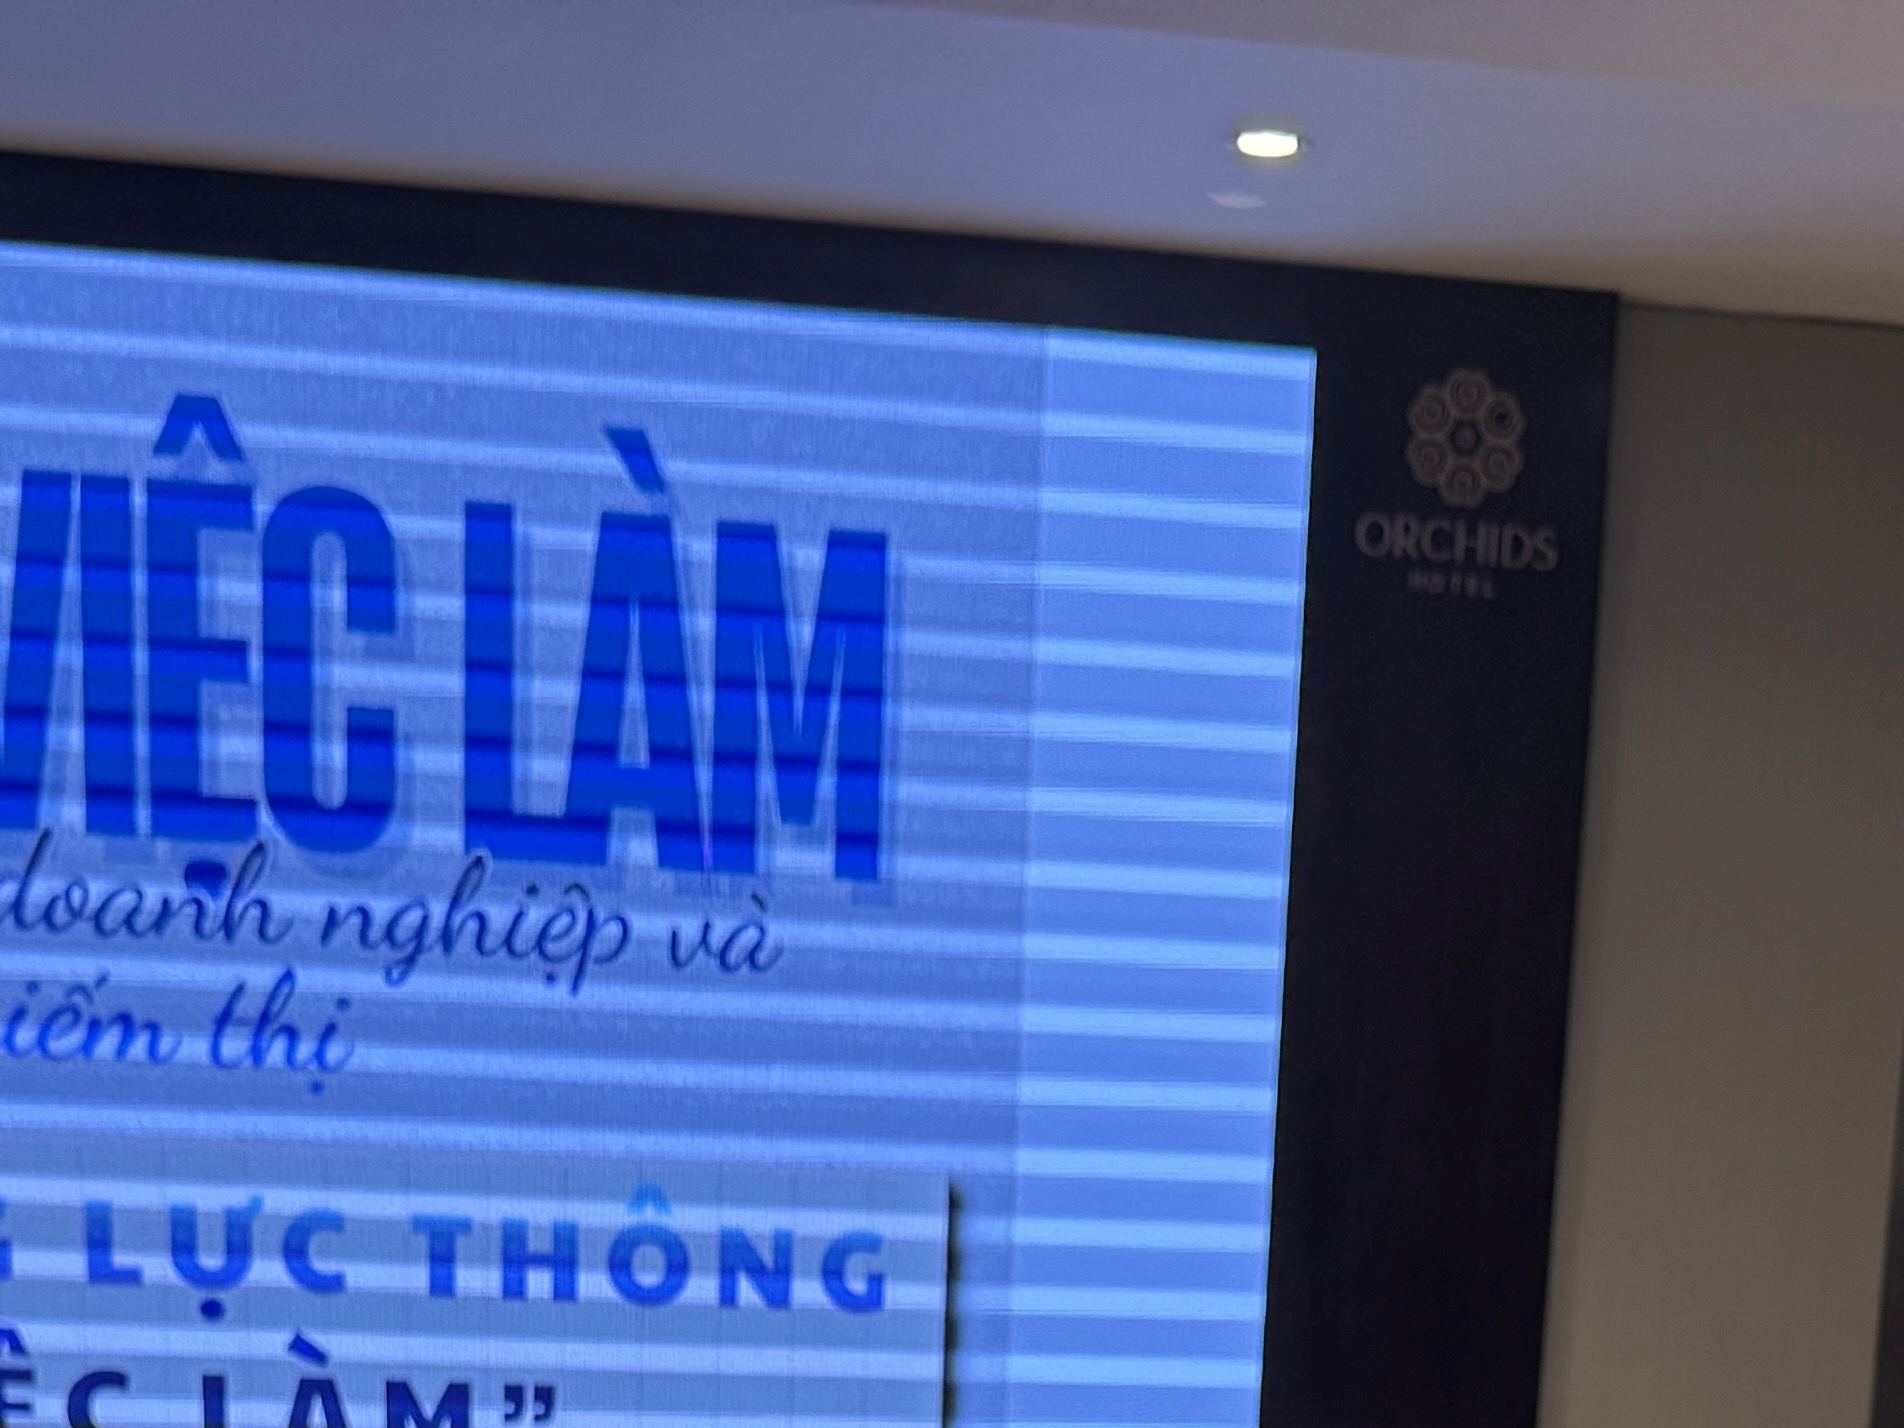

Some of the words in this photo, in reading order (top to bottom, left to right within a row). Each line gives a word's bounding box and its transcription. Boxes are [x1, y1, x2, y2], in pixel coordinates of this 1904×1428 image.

[1354, 511, 1559, 572] ORCHIDS
[461, 426, 888, 882] LÀM
[318, 853, 634, 996] nghiệp
[665, 891, 785, 974] và
[208, 969, 356, 1098] thị
[84, 1194, 346, 1323] LỰC
[410, 1183, 886, 1314] THÔNG
